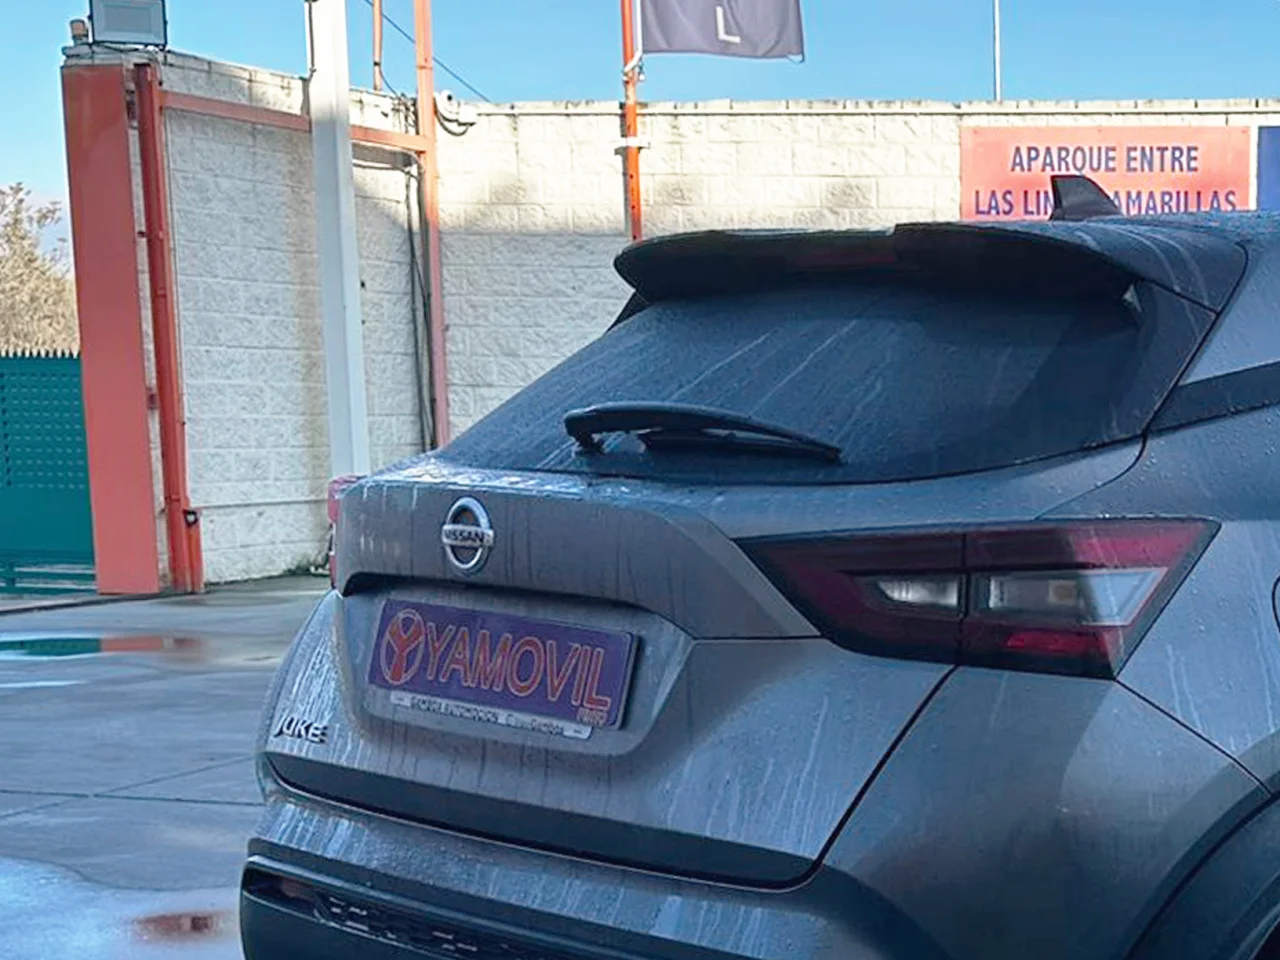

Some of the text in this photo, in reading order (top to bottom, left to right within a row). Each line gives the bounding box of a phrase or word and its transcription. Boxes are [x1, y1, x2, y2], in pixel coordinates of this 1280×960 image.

[1011, 146, 1198, 172] APARQUE ENTRE
[975, 190, 1013, 215] LAS
[1023, 190, 1054, 215] LIN
[445, 529, 484, 542] NISSAN
[426, 622, 612, 710] YAMOVIL
[274, 709, 328, 743] JUKE
